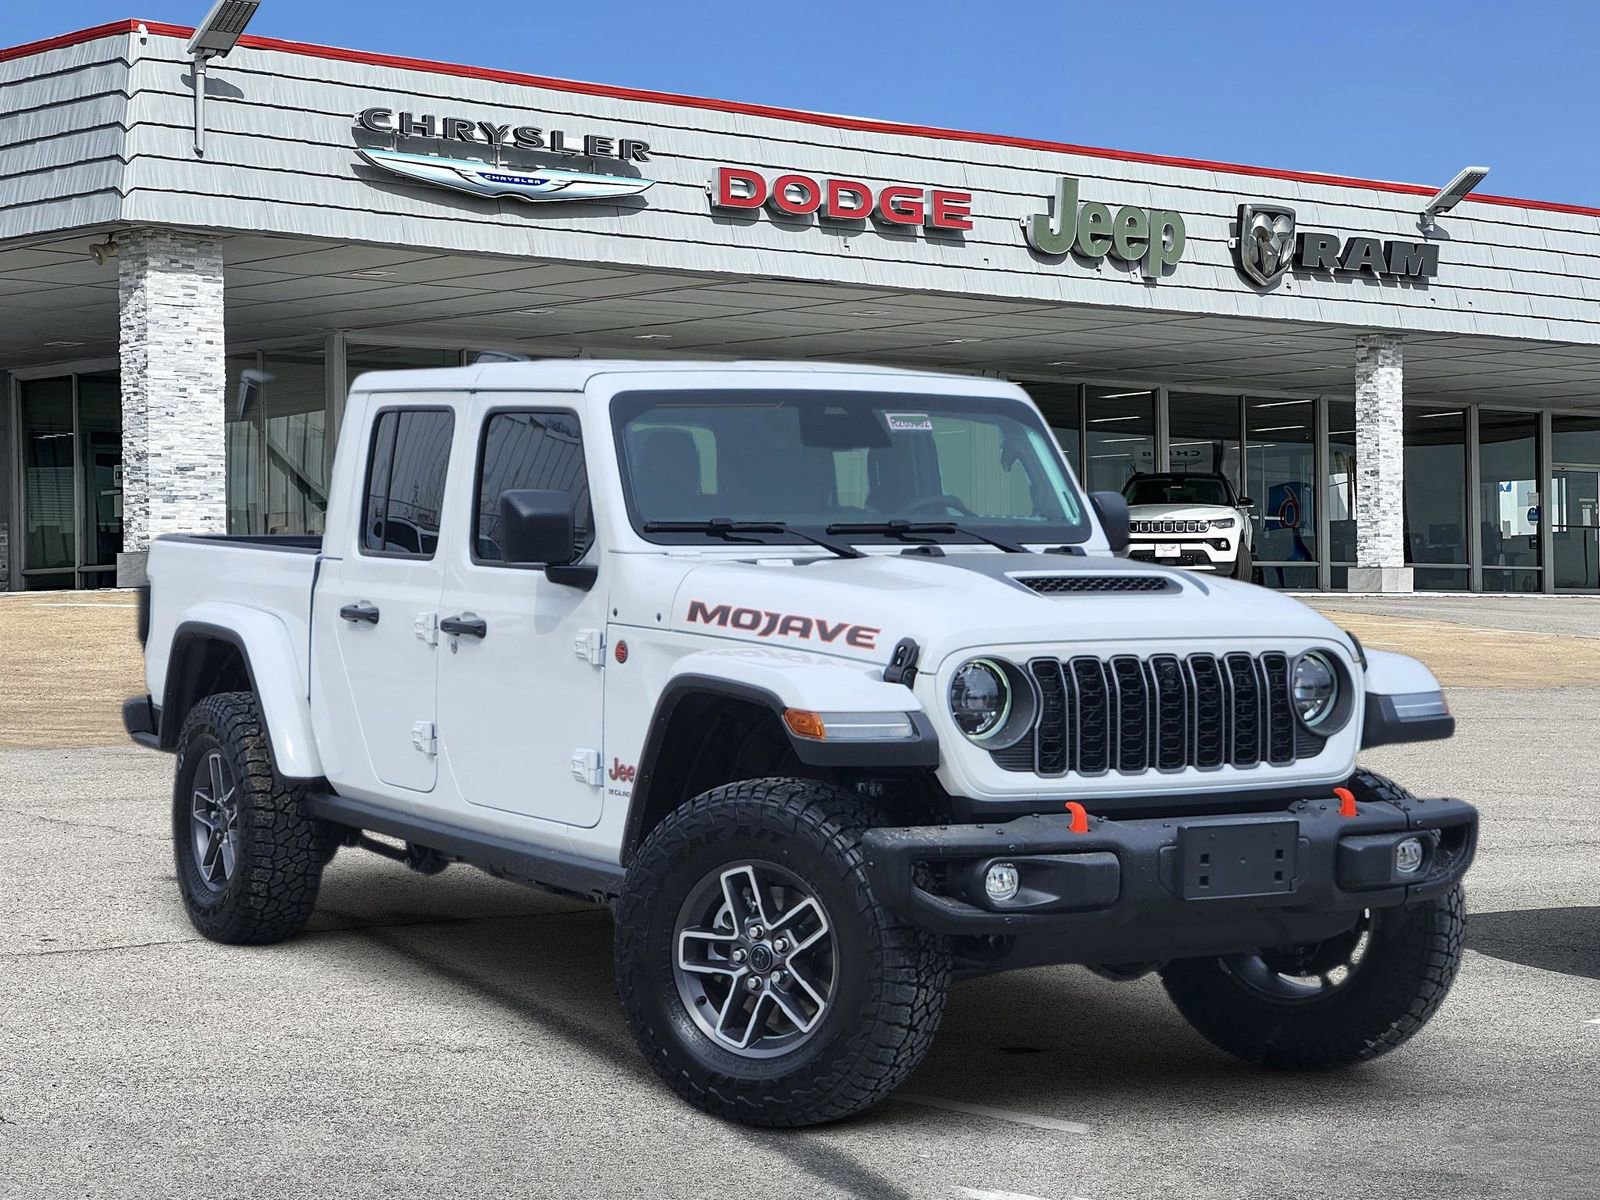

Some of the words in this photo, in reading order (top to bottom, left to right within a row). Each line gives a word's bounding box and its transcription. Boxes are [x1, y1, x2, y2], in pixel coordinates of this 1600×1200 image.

[356, 107, 651, 162] CHRYSLER
[484, 174, 541, 185] CHRYSLER
[711, 166, 973, 231] DODGE
[1025, 177, 1186, 279] Jeep
[1297, 232, 1439, 277] RAM
[687, 600, 881, 650] MOJAVE
[608, 757, 635, 782] Jee
